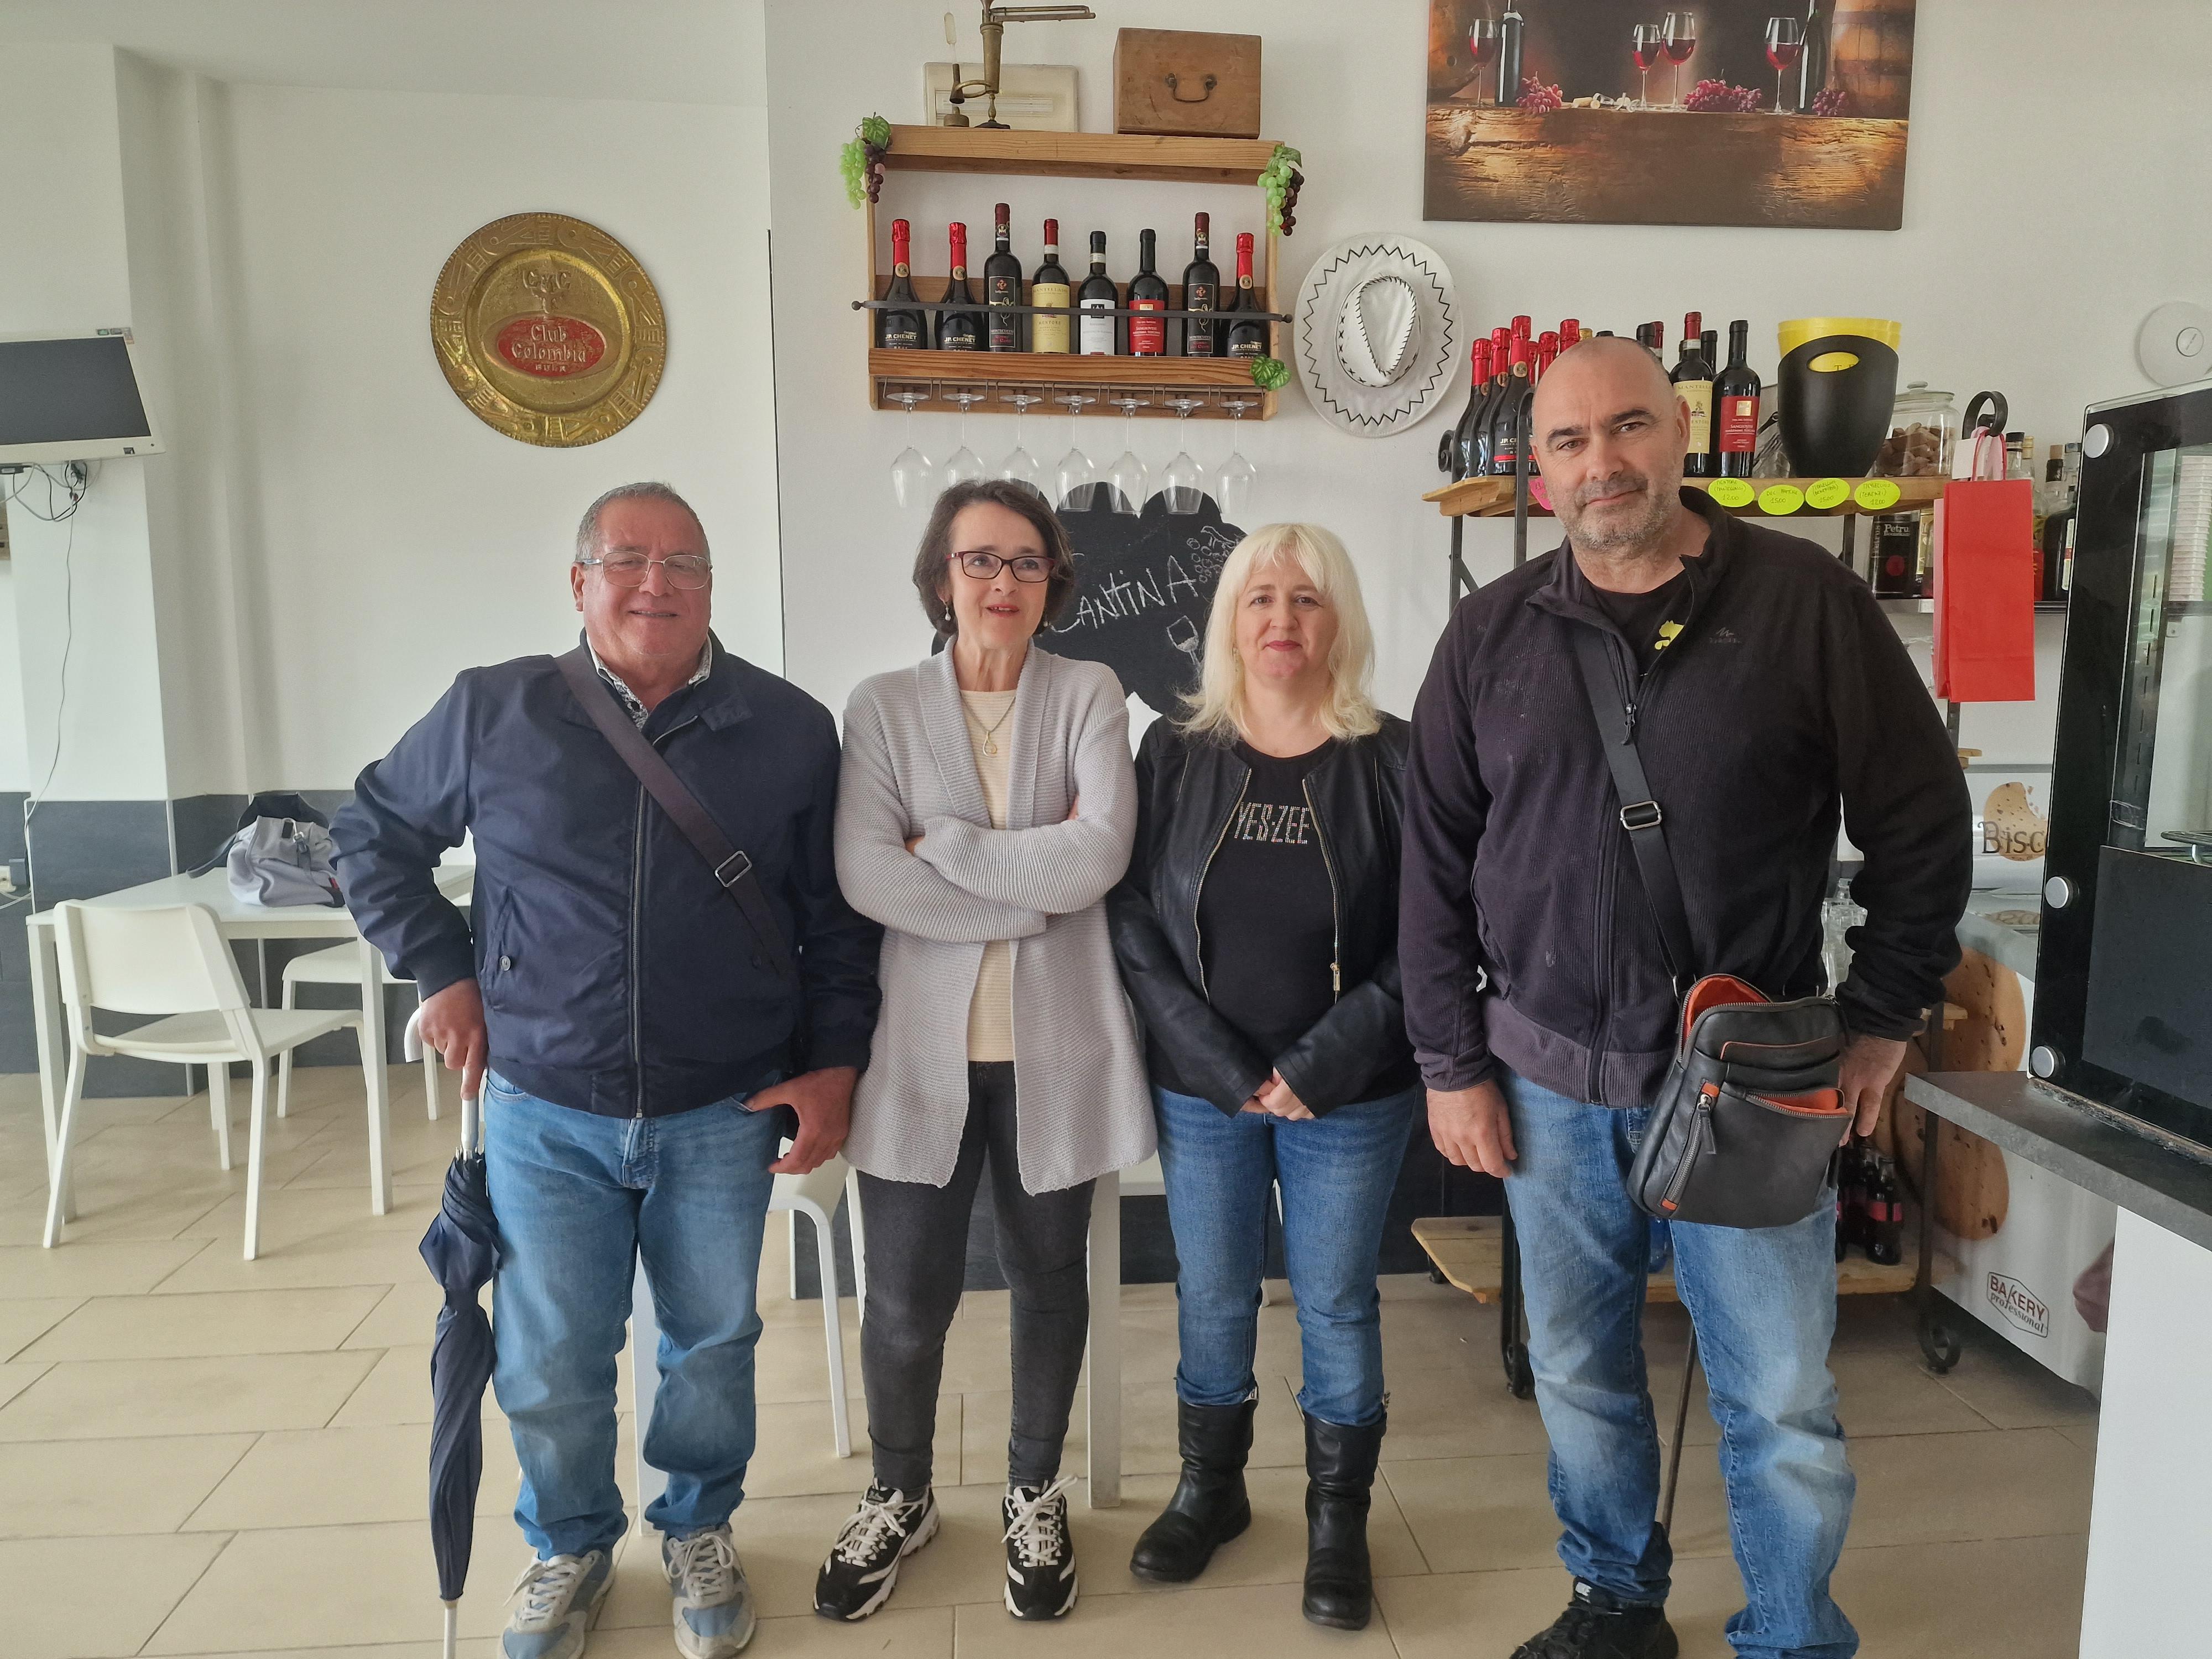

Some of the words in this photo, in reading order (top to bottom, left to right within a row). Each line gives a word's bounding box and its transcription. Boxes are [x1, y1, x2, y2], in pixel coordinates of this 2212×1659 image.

[531, 324, 568, 342] Club
[512, 341, 587, 363] Colombia
[1885, 524, 1910, 533] Petru
[1991, 1275, 2046, 1322] BAKERY
[1991, 1291, 2044, 1334] professional
